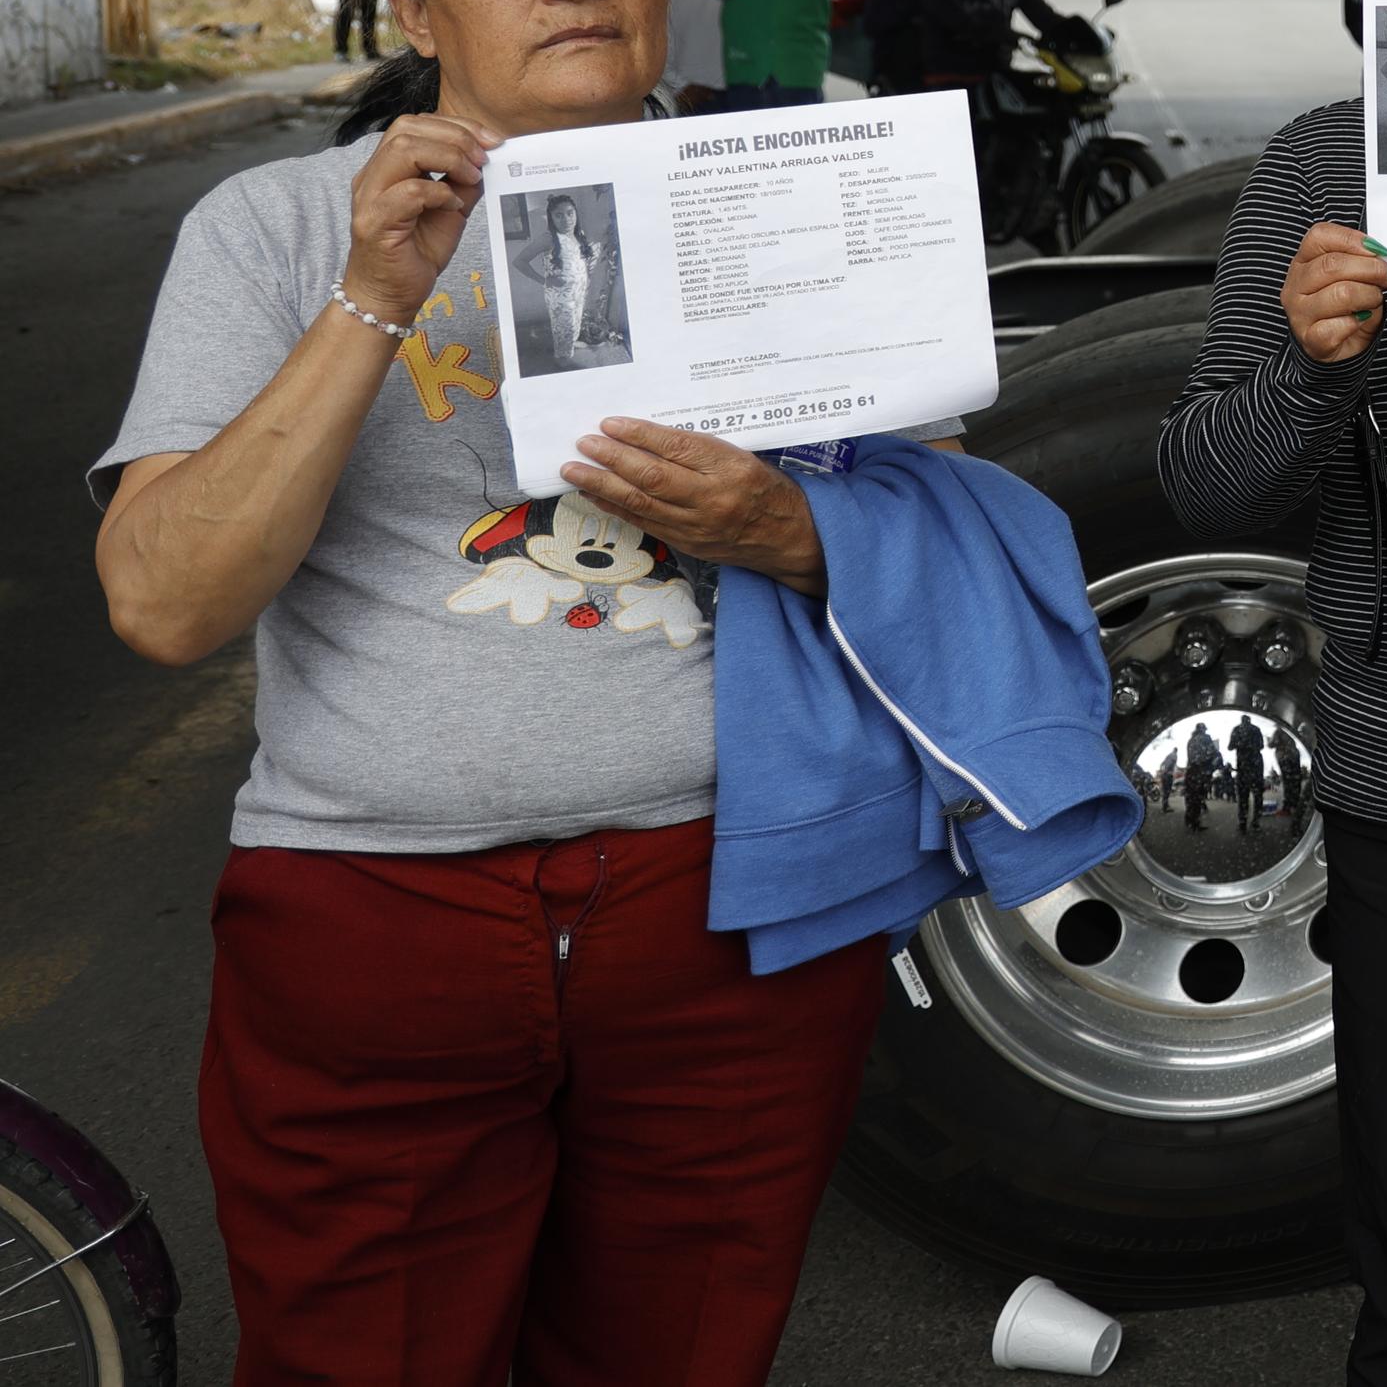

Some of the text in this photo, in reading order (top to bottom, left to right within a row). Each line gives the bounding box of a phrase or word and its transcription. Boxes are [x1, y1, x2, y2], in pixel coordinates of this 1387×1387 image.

[678, 120, 895, 161] ¡HASTA ENCONTRARLE!
[667, 150, 874, 181] LEILANY VALENTINA ARRIAGA VALDES
[700, 417, 722, 431] 09
[725, 414, 746, 427] 27
[762, 406, 793, 421] 800
[797, 401, 828, 416] 216
[832, 398, 853, 411] 03
[857, 395, 876, 407] 61
